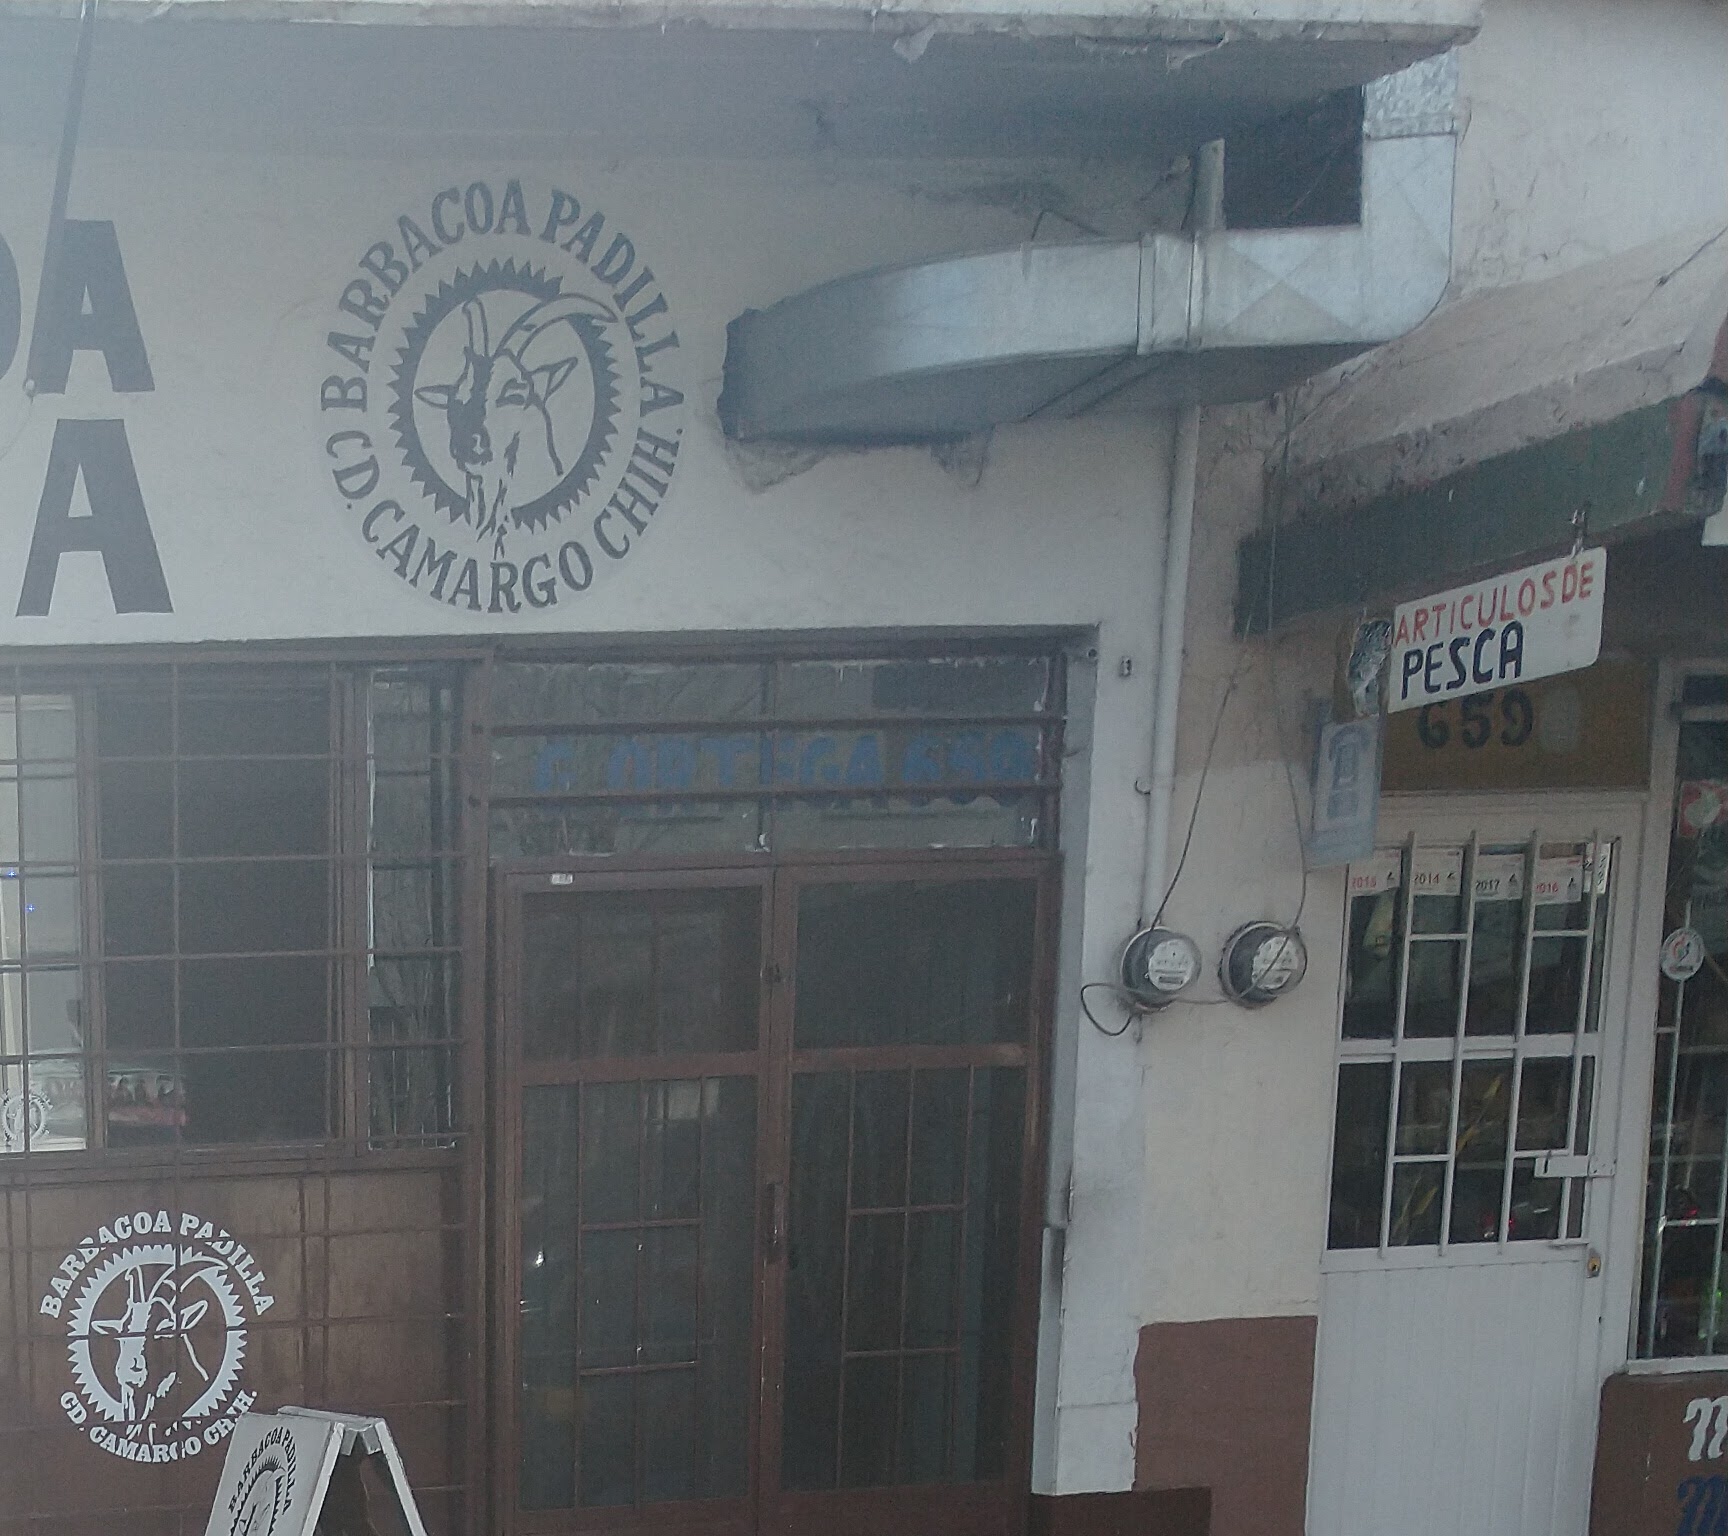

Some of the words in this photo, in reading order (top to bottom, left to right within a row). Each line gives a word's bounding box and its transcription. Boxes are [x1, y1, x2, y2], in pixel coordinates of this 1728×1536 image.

[320, 178, 532, 413] BARBACOA
[539, 187, 685, 418] PADILLA
[360, 499, 595, 614] CAMARGO
[593, 426, 684, 561] CHIH.
[1401, 619, 1524, 700] PESCA
[1416, 691, 1535, 751] 659
[39, 1210, 172, 1319] BARBACOA
[179, 1212, 276, 1316] PADILLA
[228, 1426, 284, 1514] BARBACOA
[280, 1427, 298, 1516] PADILLA
